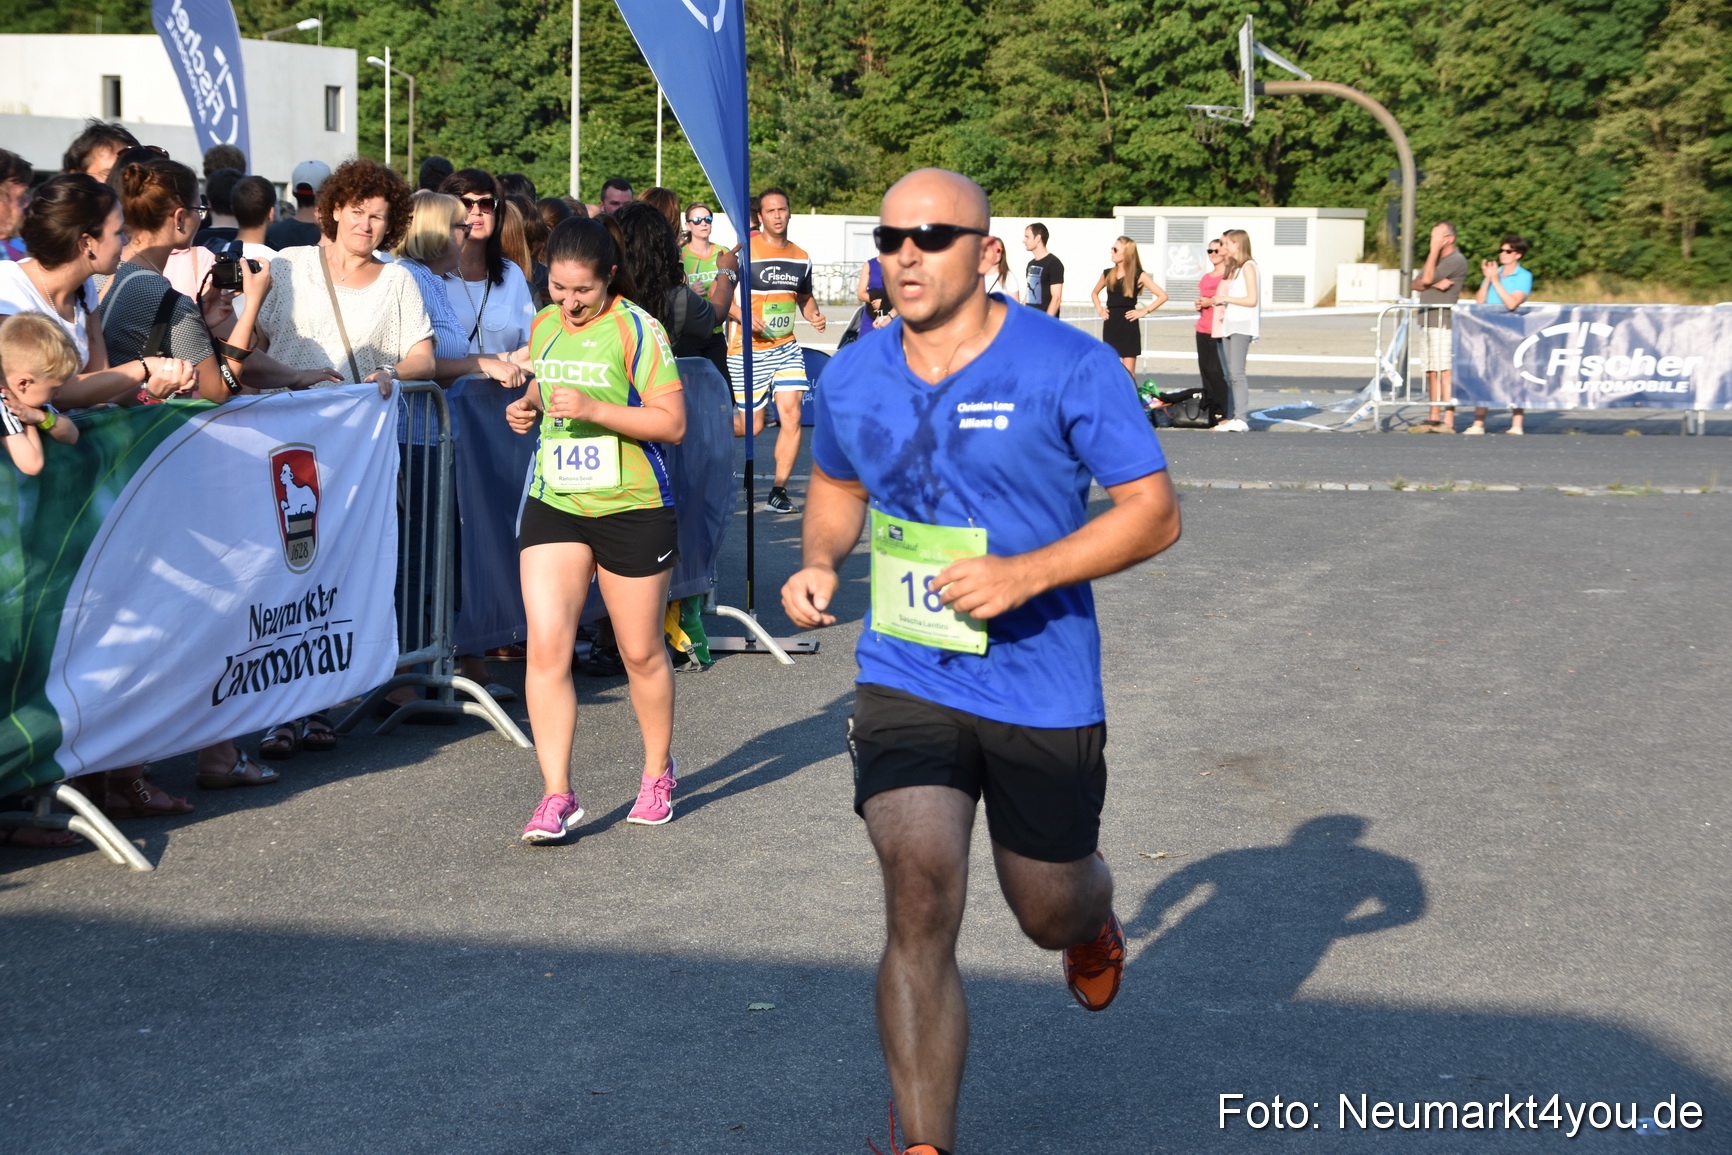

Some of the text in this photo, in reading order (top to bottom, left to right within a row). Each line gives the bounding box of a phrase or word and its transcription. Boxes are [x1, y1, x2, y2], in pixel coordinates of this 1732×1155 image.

[688, 271, 718, 285] BOC
[768, 268, 799, 281] Fischer
[769, 316, 790, 328] 409
[1546, 341, 1706, 377] Fischer
[220, 364, 238, 388] SONY
[533, 359, 612, 388] BOCK
[1560, 380, 1690, 393] AUTOMOBILE
[957, 401, 992, 413] Christian
[959, 417, 993, 429] Allianz
[553, 445, 601, 470] 148
[290, 540, 309, 561] 1628
